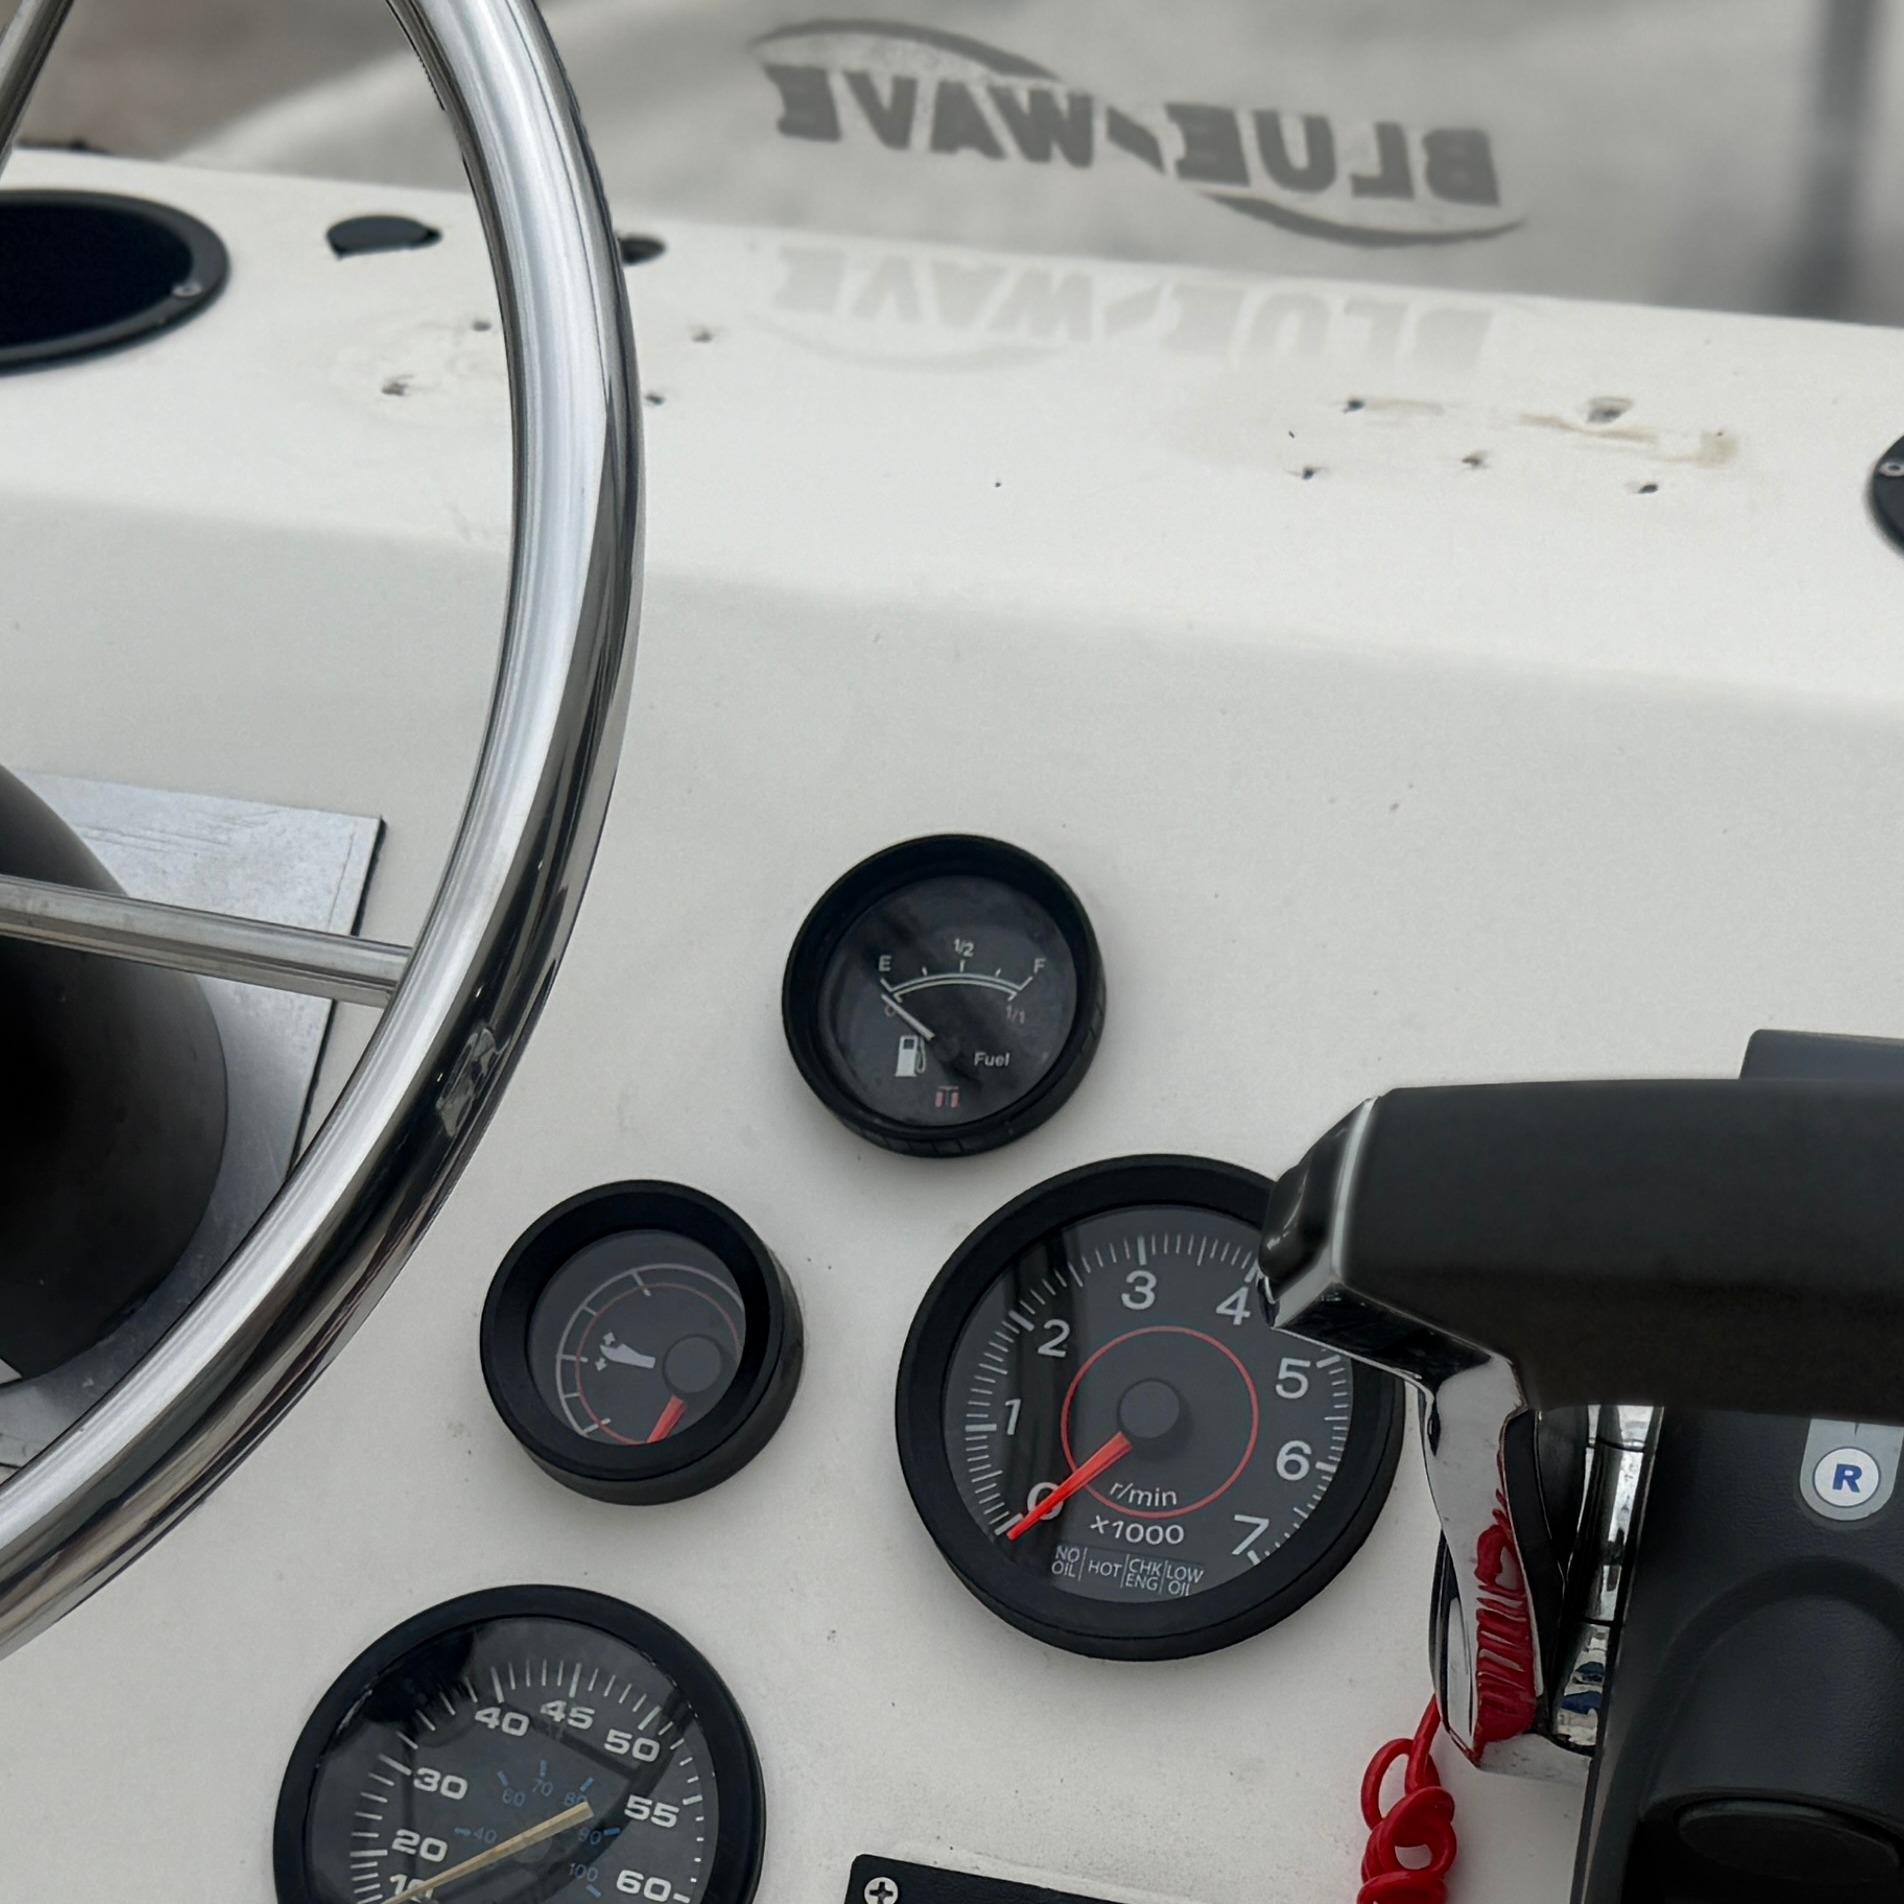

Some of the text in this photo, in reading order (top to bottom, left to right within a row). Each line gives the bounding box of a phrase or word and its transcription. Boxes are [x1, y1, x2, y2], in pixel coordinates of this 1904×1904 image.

[953, 938, 975, 957] 1/2
[878, 955, 892, 972] E
[1033, 957, 1047, 974] F
[1005, 1005, 1026, 1025] 1/1
[974, 1052, 1011, 1067] Fuel
[1121, 1270, 1158, 1311] 3
[1215, 1285, 1252, 1326] 4
[1037, 1319, 1072, 1358] 2
[1274, 1357, 1312, 1399] 5
[1004, 1398, 1023, 1436] 1
[1275, 1439, 1314, 1481] 6
[1832, 1463, 1863, 1493] R
[1026, 1482, 1065, 1521] 0
[1109, 1482, 1177, 1507] r/min
[1230, 1514, 1271, 1557] 7
[1055, 1545, 1081, 1562] NO
[1088, 1560, 1123, 1577] HOT
[1128, 1558, 1163, 1576] CHK
[1051, 1560, 1076, 1578] OIL
[1125, 1573, 1159, 1591] ENG
[1166, 1564, 1205, 1584] LOW
[474, 1706, 530, 1737] 40
[539, 1700, 595, 1731] 45
[603, 1729, 661, 1763] 50
[412, 1766, 469, 1801] 30
[532, 1777, 554, 1798] 70
[624, 1794, 681, 1829] 55
[391, 1829, 449, 1863] 20
[473, 1827, 498, 1844] 40
[569, 1862, 600, 1883] 100
[615, 1869, 672, 1904] 60
